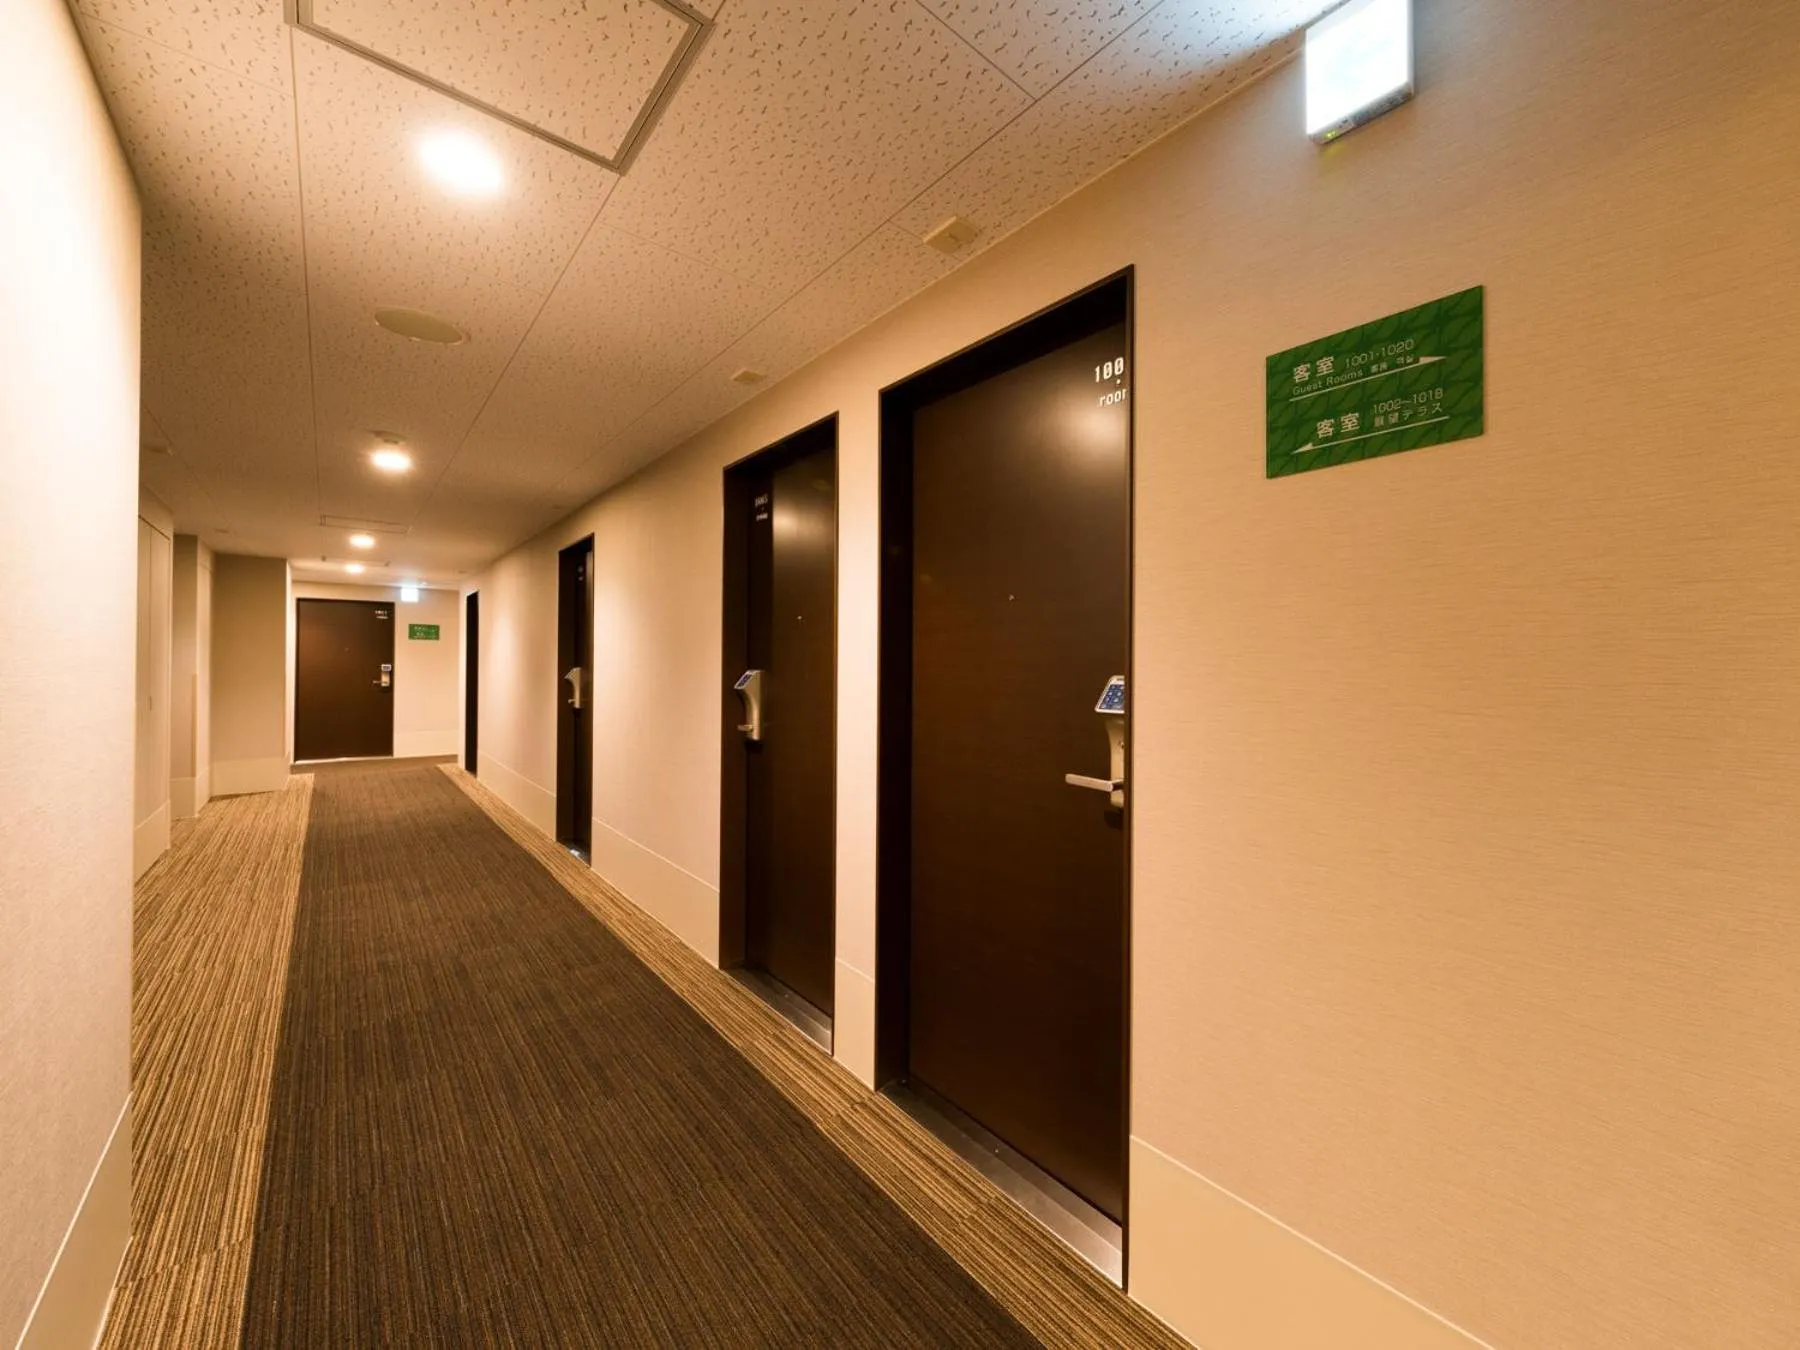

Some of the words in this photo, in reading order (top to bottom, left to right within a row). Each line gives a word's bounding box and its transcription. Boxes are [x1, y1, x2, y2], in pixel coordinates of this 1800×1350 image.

[1293, 356, 1335, 382] 客室
[1292, 382, 1323, 396] Guest
[1326, 370, 1363, 386] Rooms
[1316, 413, 1360, 439] 客室
